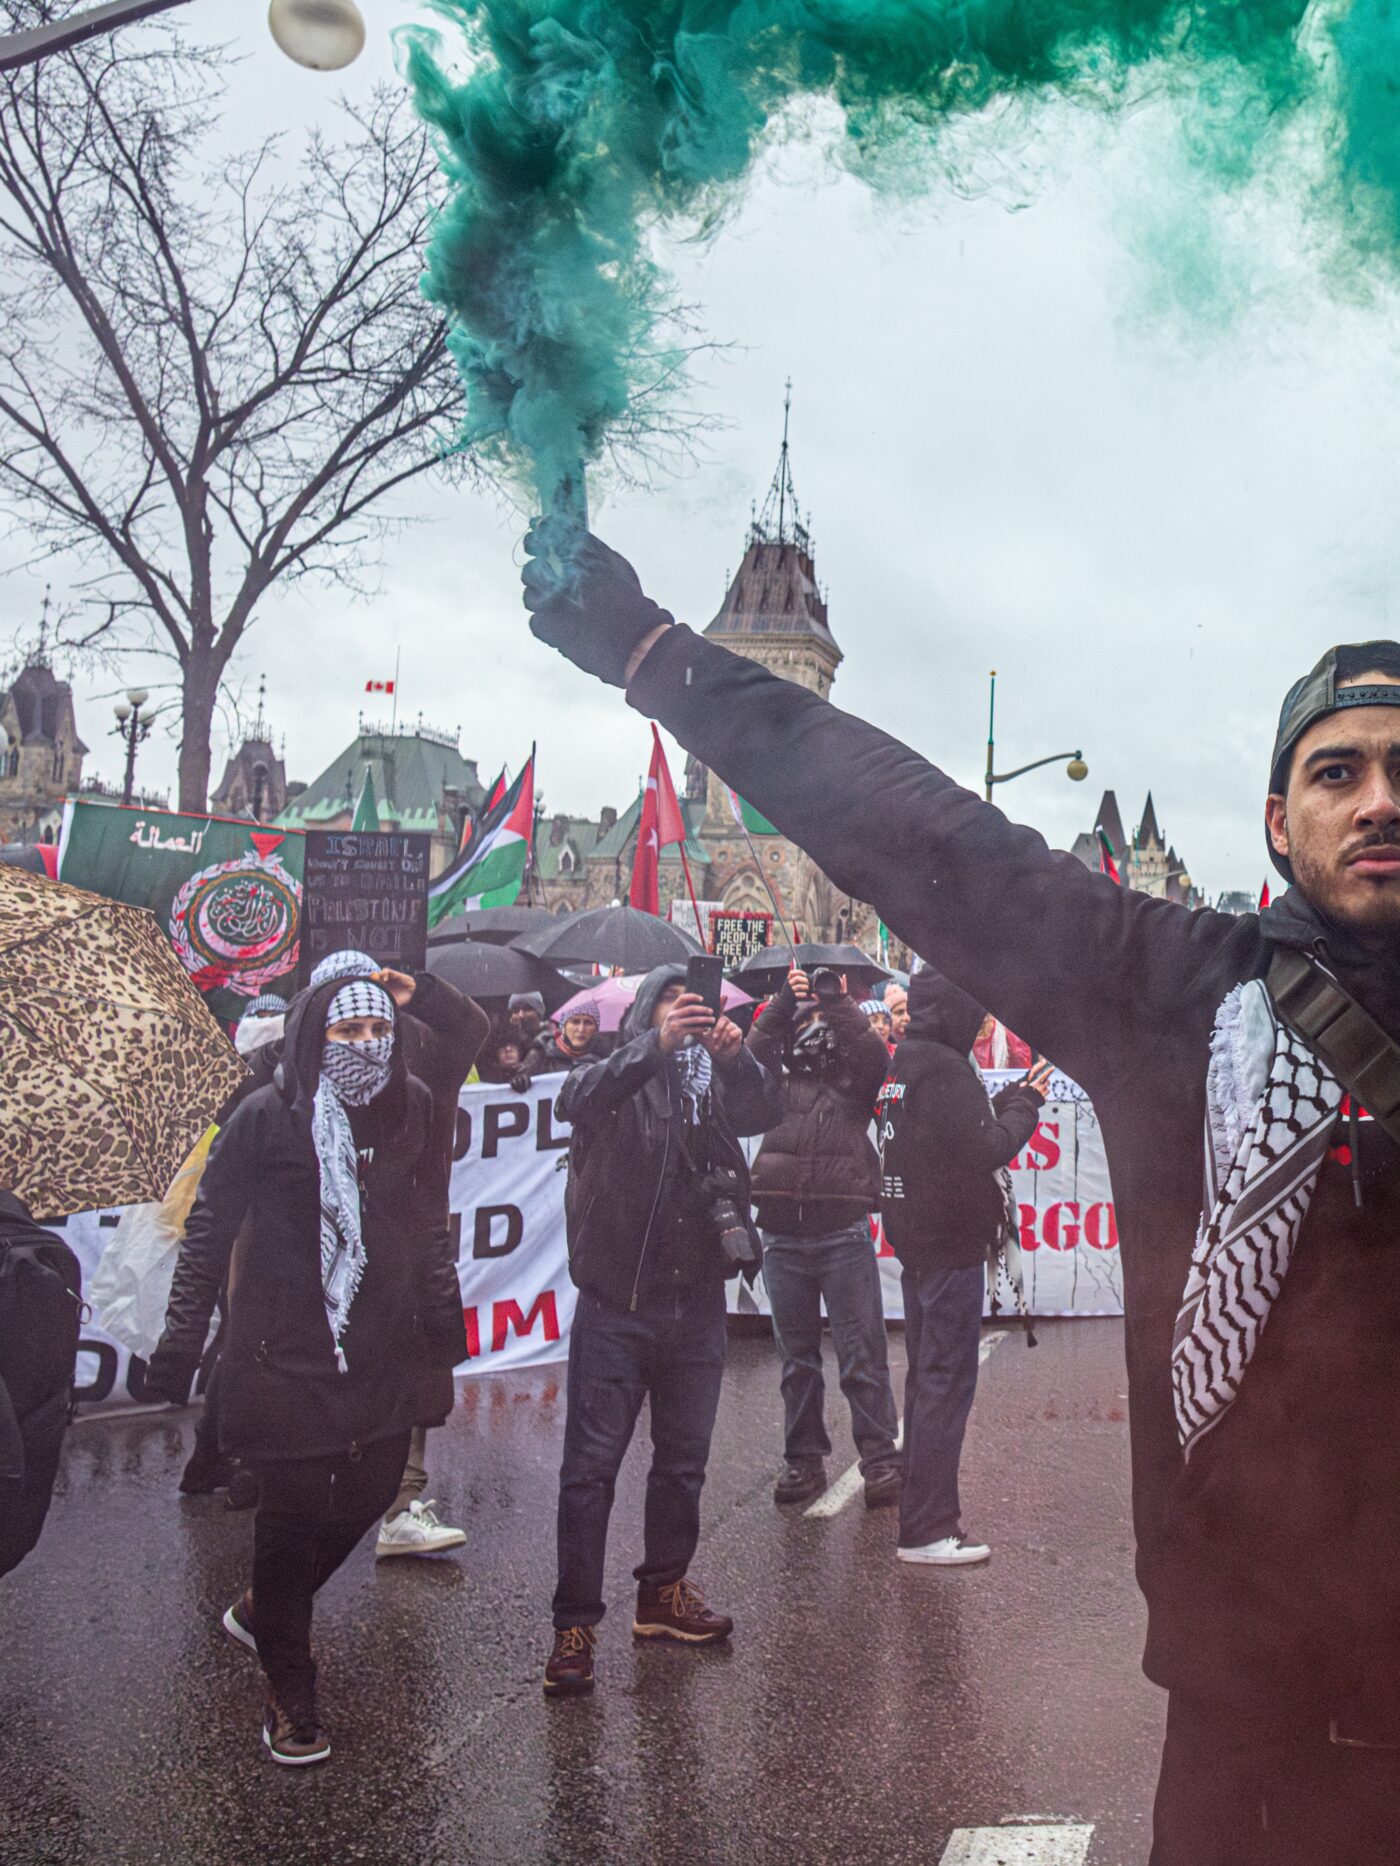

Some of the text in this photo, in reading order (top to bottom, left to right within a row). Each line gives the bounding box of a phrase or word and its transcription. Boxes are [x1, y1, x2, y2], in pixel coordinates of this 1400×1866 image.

[717, 919, 765, 932] FREE THE
[716, 943, 742, 956] FREE
